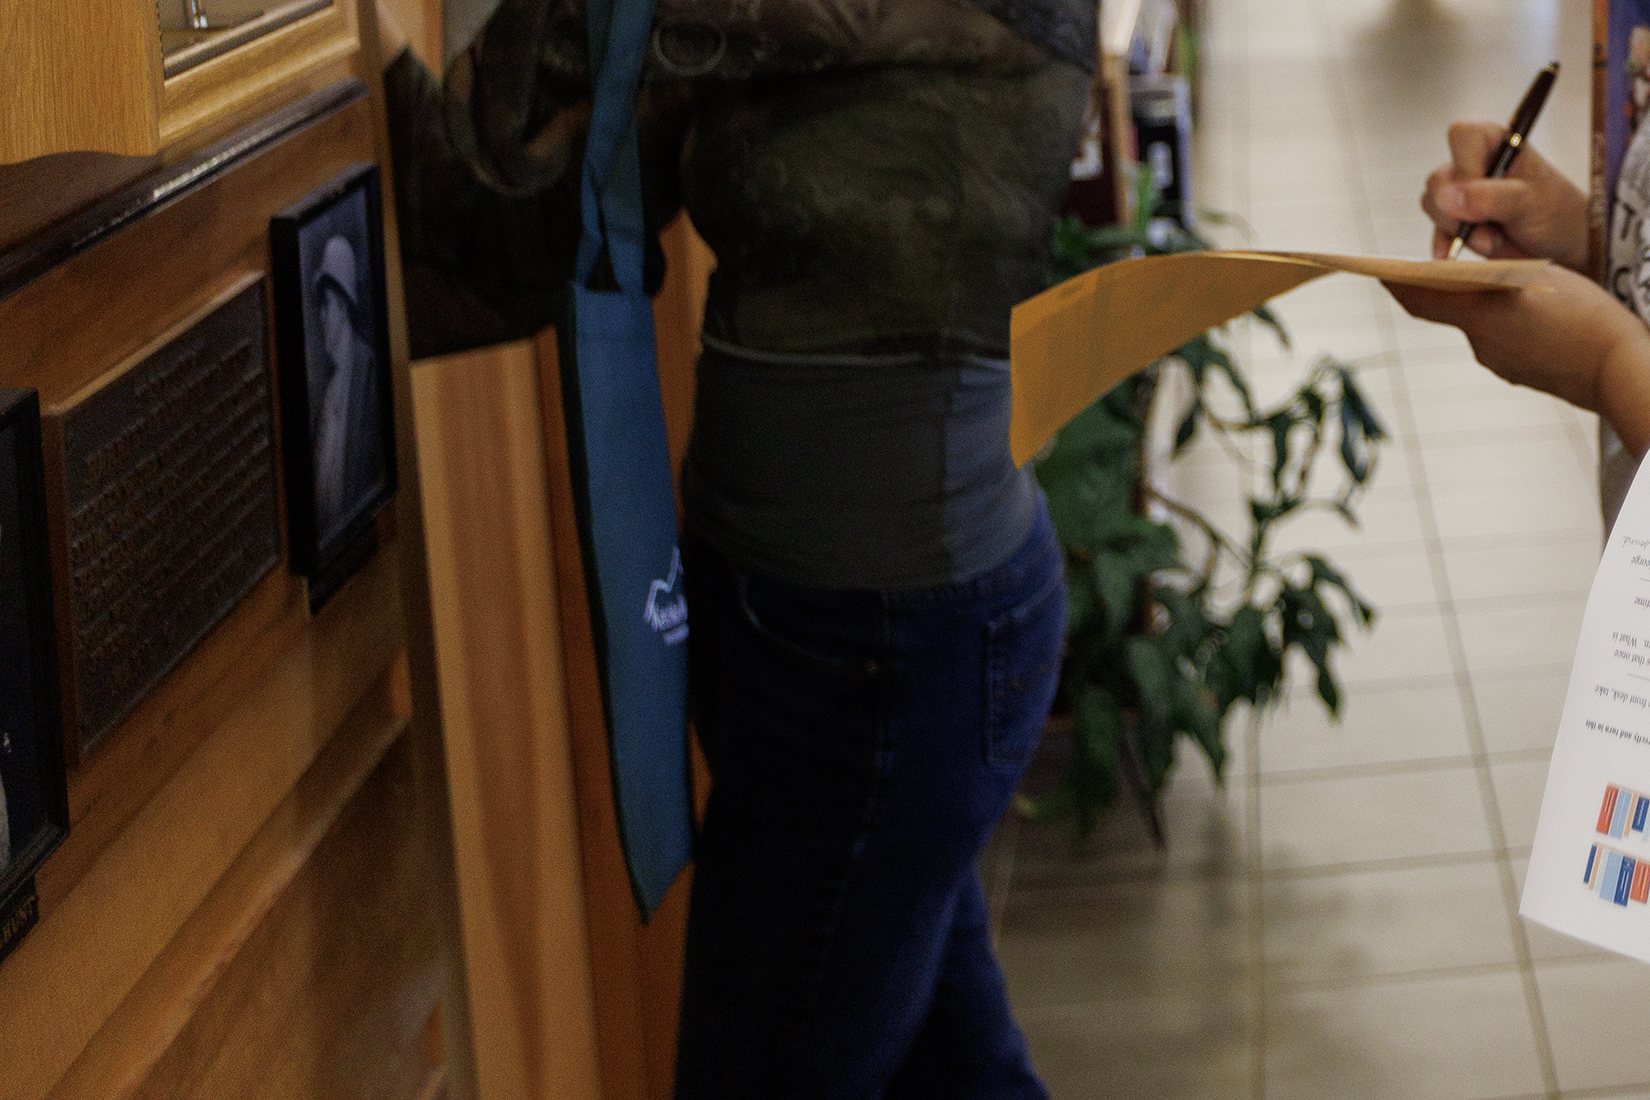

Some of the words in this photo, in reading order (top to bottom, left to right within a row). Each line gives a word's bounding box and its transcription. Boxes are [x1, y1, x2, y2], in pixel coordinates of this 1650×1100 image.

[1622, 536, 1649, 550] sound
[1612, 633, 1619, 643] is
[1619, 635, 1639, 649] What
[1614, 651, 1631, 661] once
[1631, 655, 1646, 667] that
[1595, 686, 1610, 698] take
[1629, 696, 1648, 710] front
[1585, 721, 1597, 732] this
[1597, 724, 1605, 734] in
[1605, 727, 1619, 738] turn
[1619, 731, 1633, 741] and
